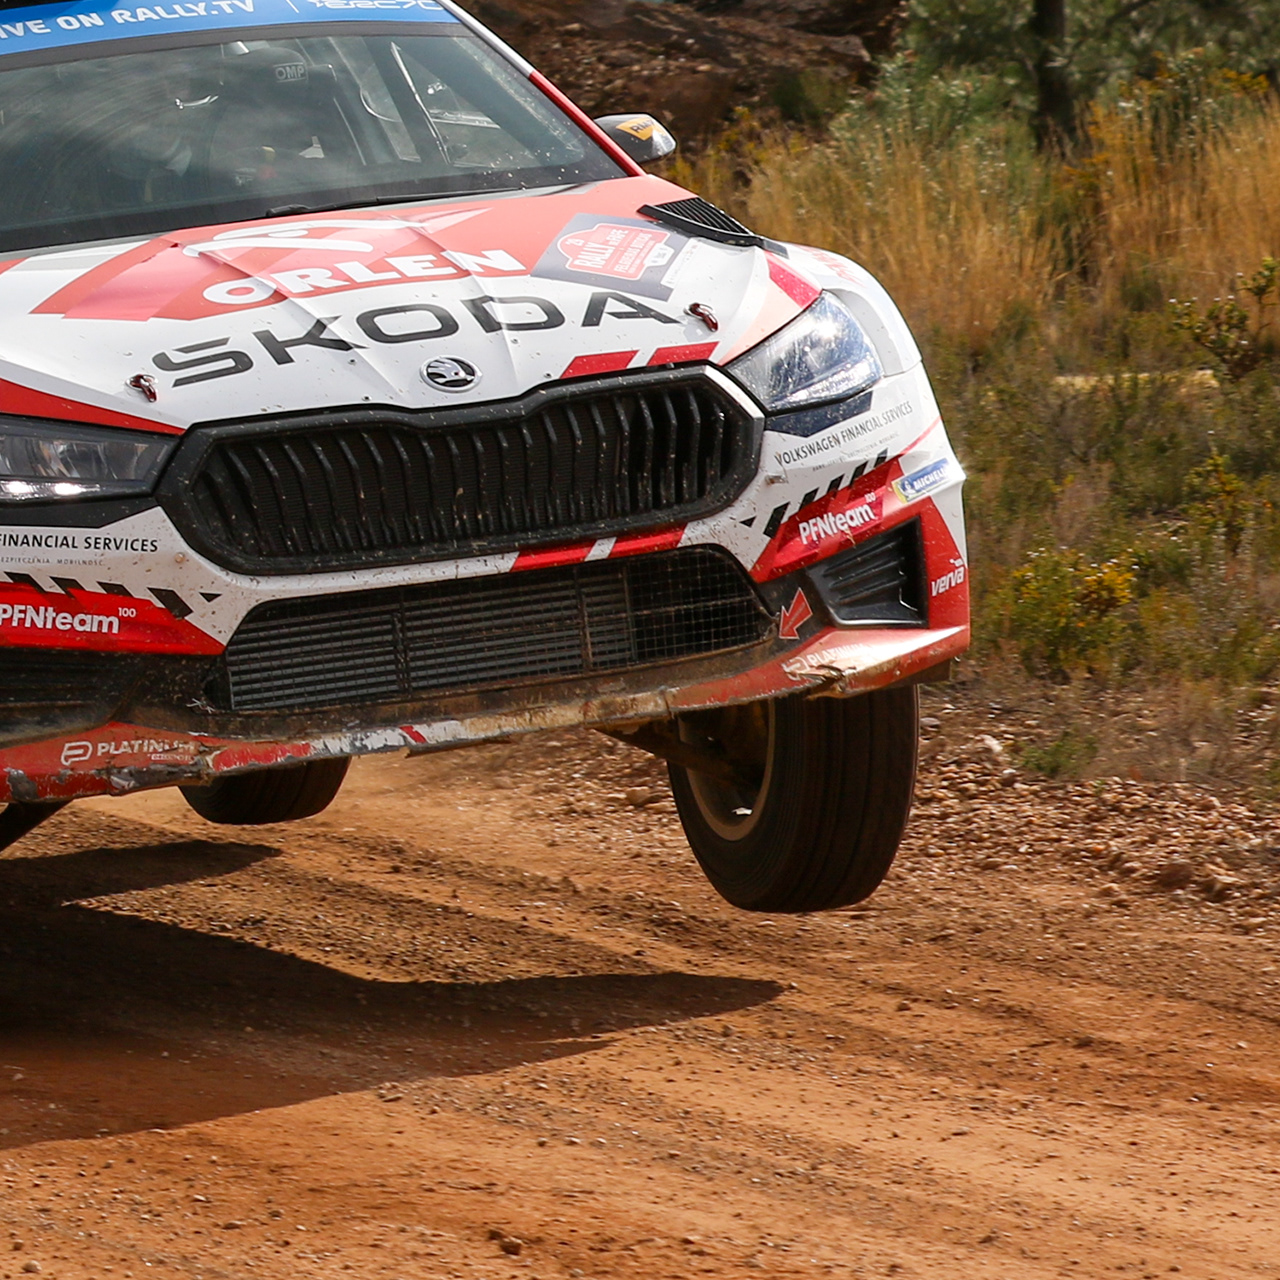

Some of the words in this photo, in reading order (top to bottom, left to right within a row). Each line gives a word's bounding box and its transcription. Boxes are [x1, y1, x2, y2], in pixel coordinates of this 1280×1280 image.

[55, 12, 105, 31] ON
[274, 65, 306, 81] OMP
[573, 241, 616, 269] RALLY
[202, 249, 528, 305] ORLEN
[773, 433, 842, 467] VOLKSWAGEN
[841, 416, 885, 444] FINANCIAL
[881, 400, 914, 425] SERVICES
[83, 536, 159, 553] SERVICES
[931, 565, 965, 597] verva
